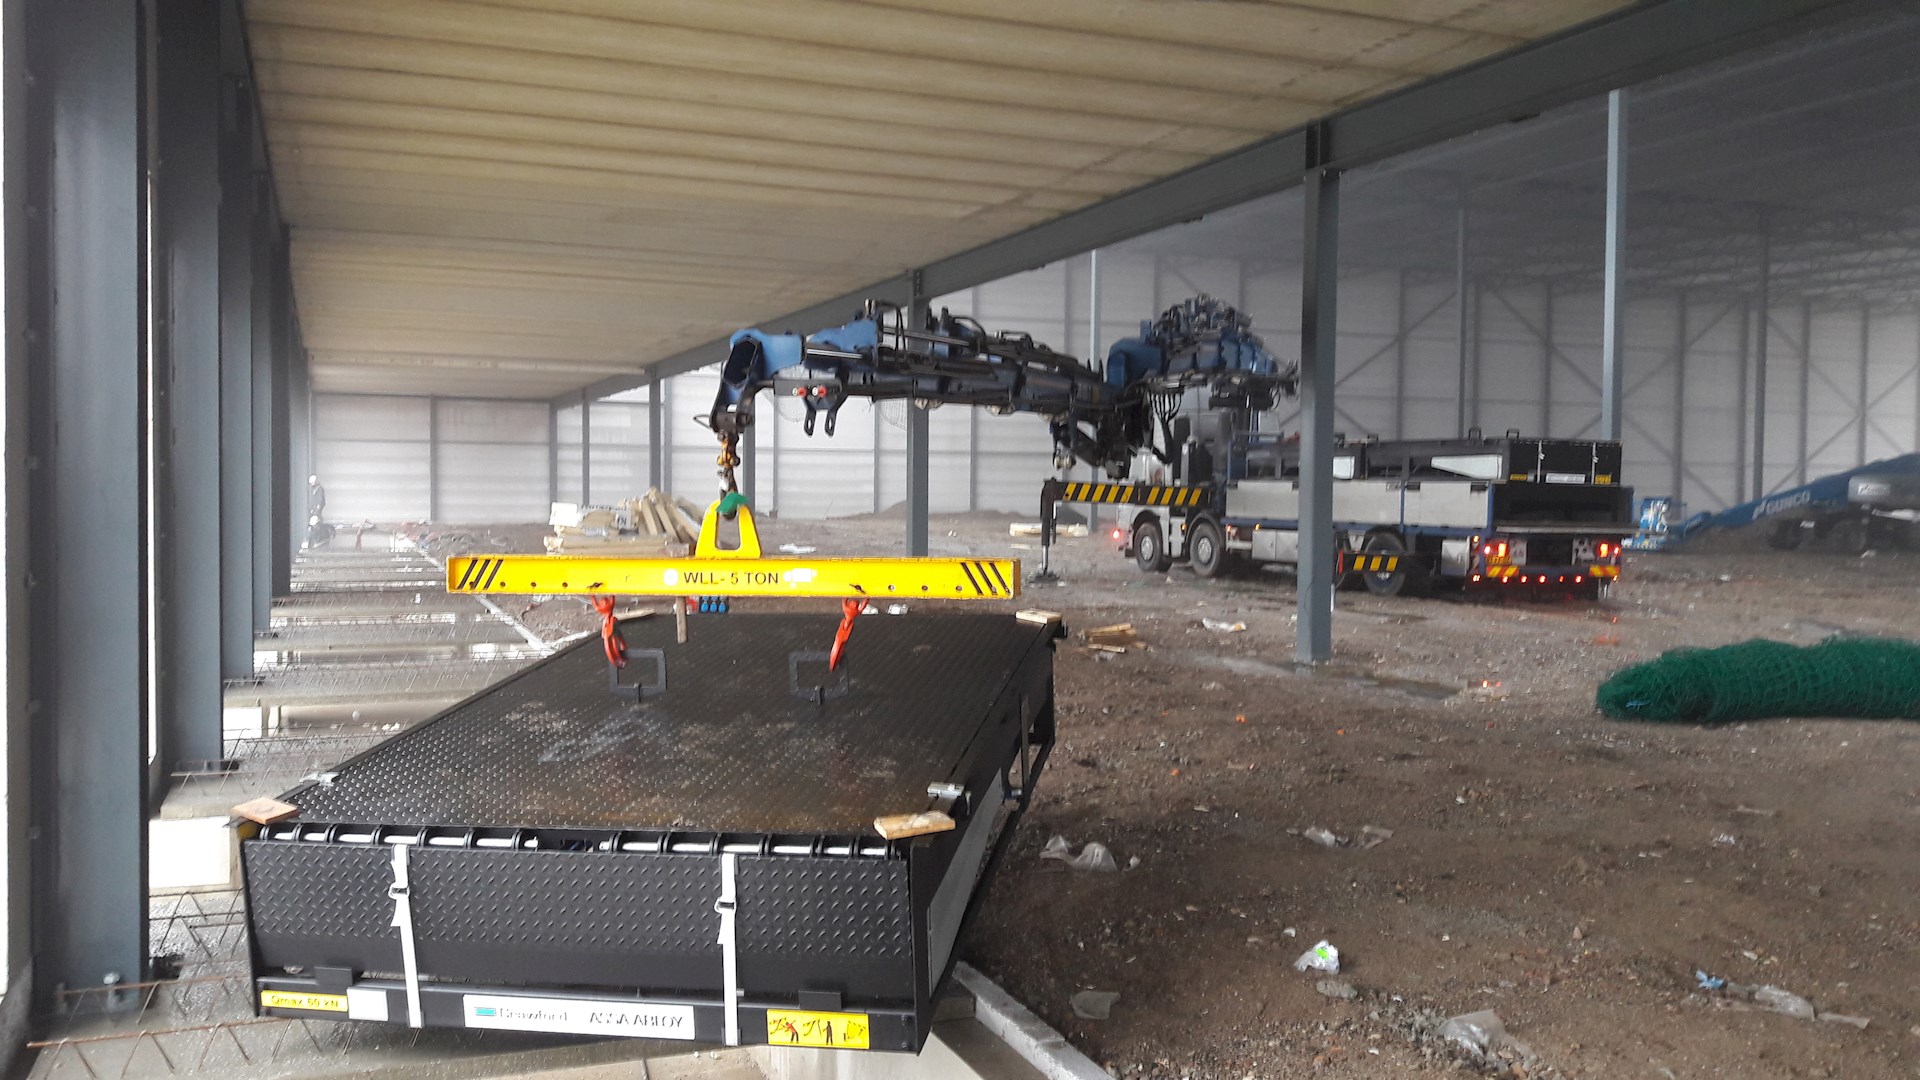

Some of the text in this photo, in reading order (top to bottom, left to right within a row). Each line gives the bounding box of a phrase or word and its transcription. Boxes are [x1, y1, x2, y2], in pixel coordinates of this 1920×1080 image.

[730, 571, 739, 585] 5
[745, 571, 779, 585] TON
[271, 995, 303, 1006] Qmax
[500, 1007, 683, 1028] Crawford ASSA ABLOY
